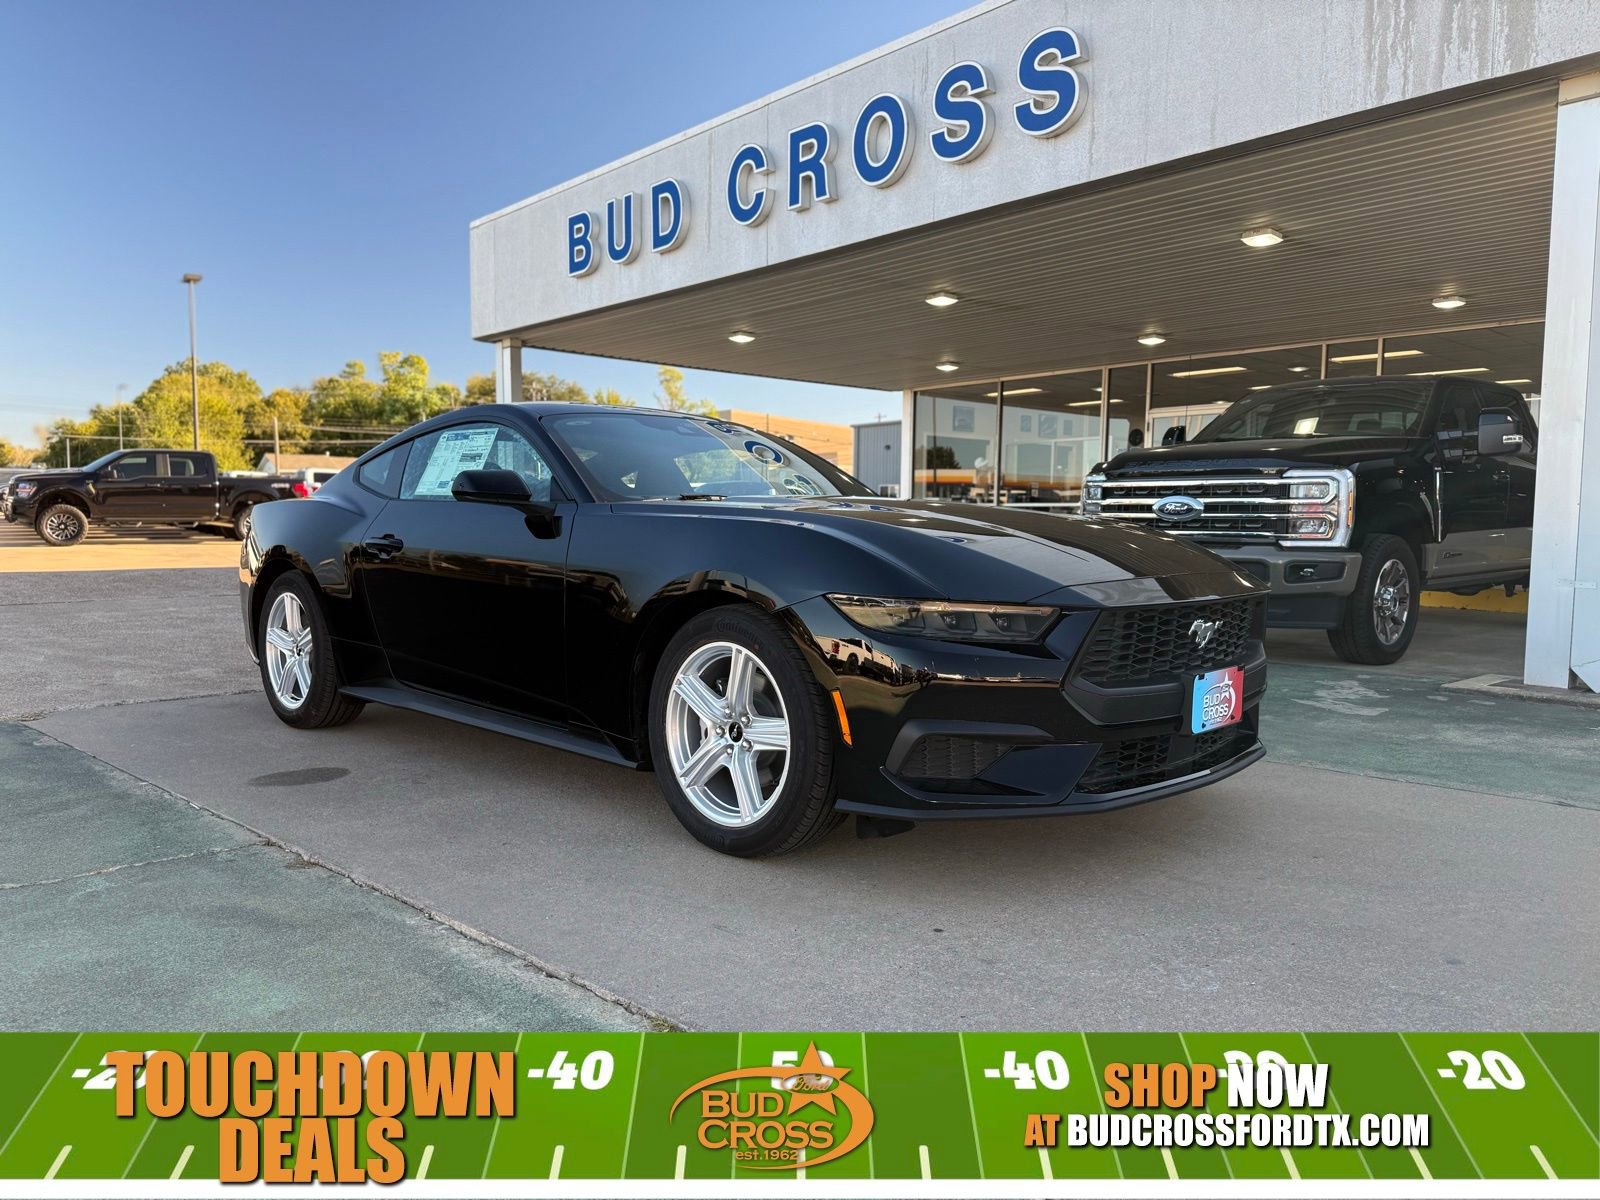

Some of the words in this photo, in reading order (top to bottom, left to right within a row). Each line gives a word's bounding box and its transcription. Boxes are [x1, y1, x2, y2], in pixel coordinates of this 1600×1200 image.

[567, 177, 690, 278] BUD
[726, 26, 1089, 228] CROSS
[1203, 693, 1220, 709] BUD
[1202, 703, 1229, 720] CROSS
